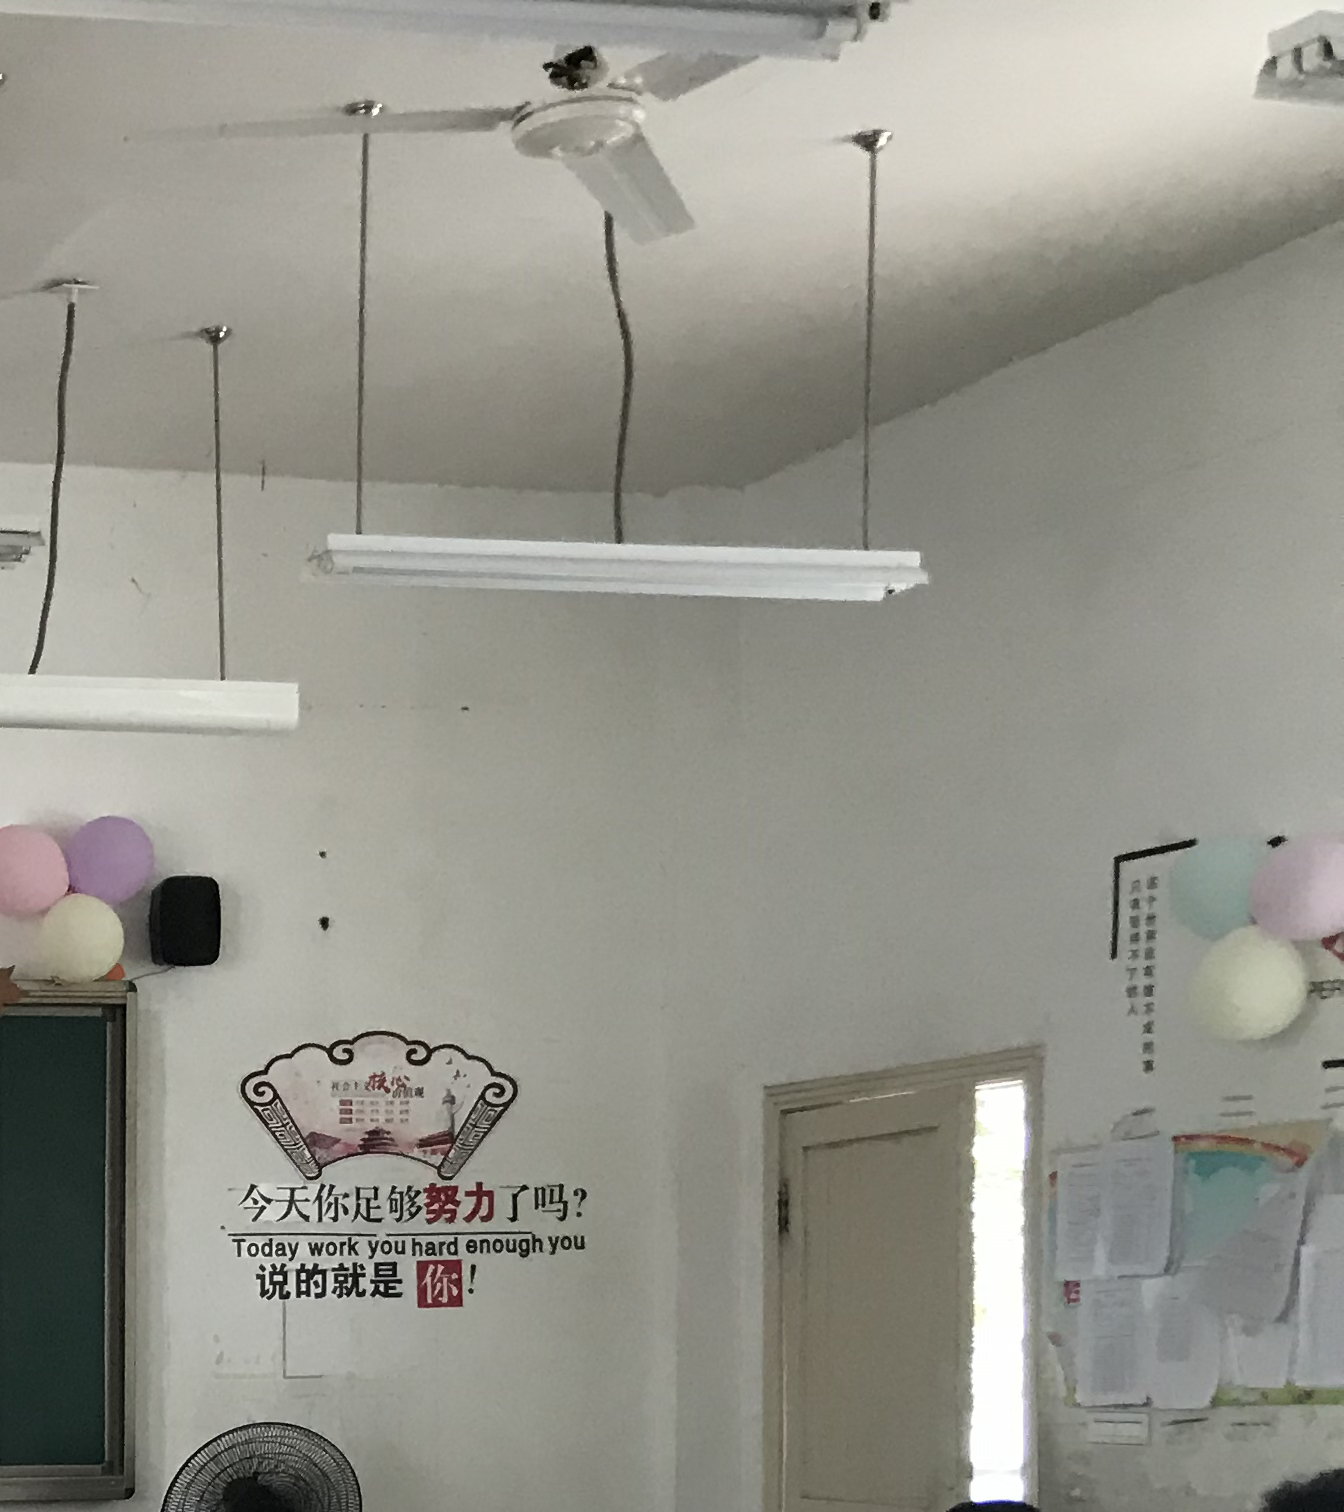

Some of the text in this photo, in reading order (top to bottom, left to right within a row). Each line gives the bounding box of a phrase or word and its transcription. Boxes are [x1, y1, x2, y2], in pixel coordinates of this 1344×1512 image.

[232, 1233, 586, 1261] Today work you hard enough you
